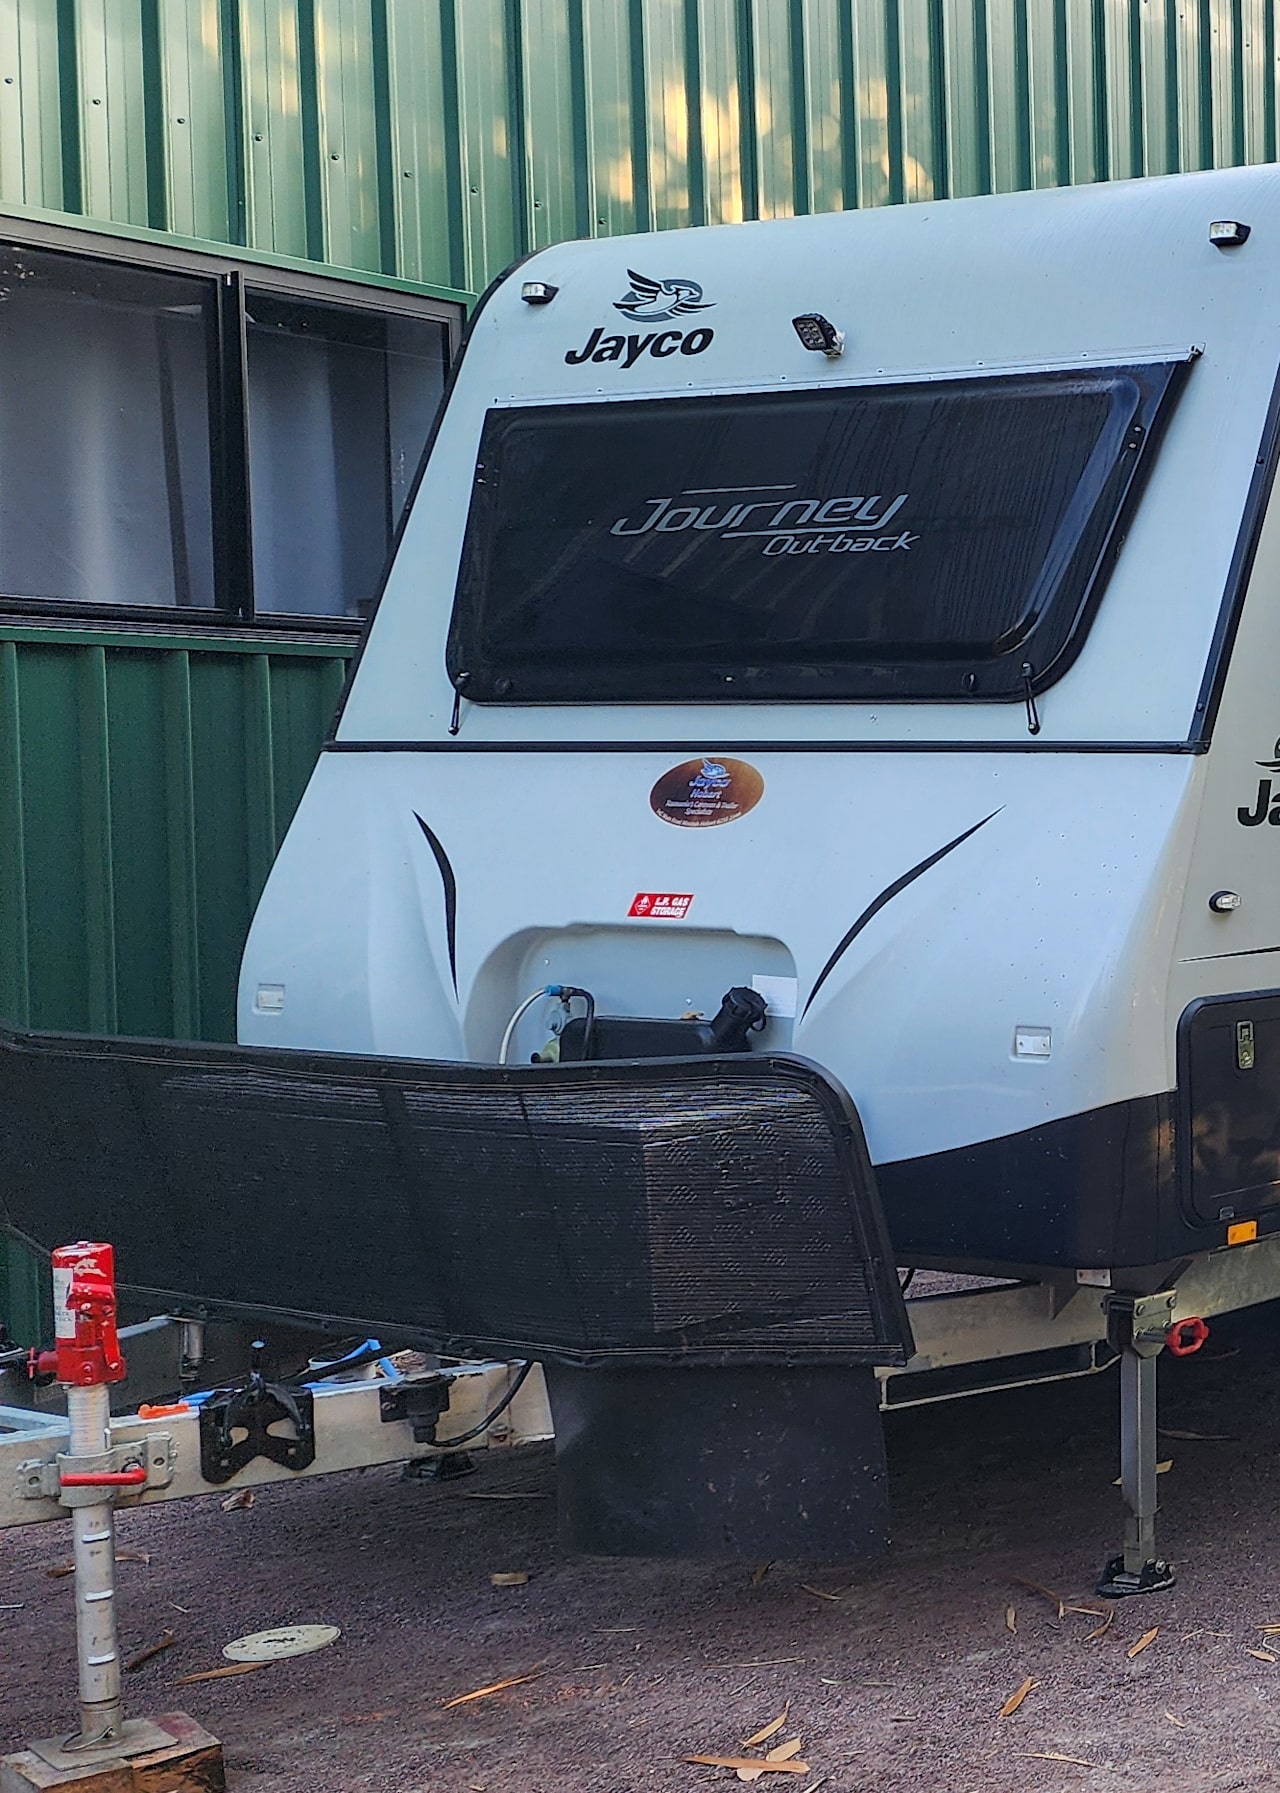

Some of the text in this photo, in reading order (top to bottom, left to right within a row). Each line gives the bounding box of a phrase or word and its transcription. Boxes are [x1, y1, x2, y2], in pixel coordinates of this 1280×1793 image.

[564, 323, 715, 370] Jayco
[609, 493, 909, 538] Journey
[760, 529, 920, 558] Outback
[650, 906, 686, 916] STORAGE
[671, 897, 690, 907] GAS
